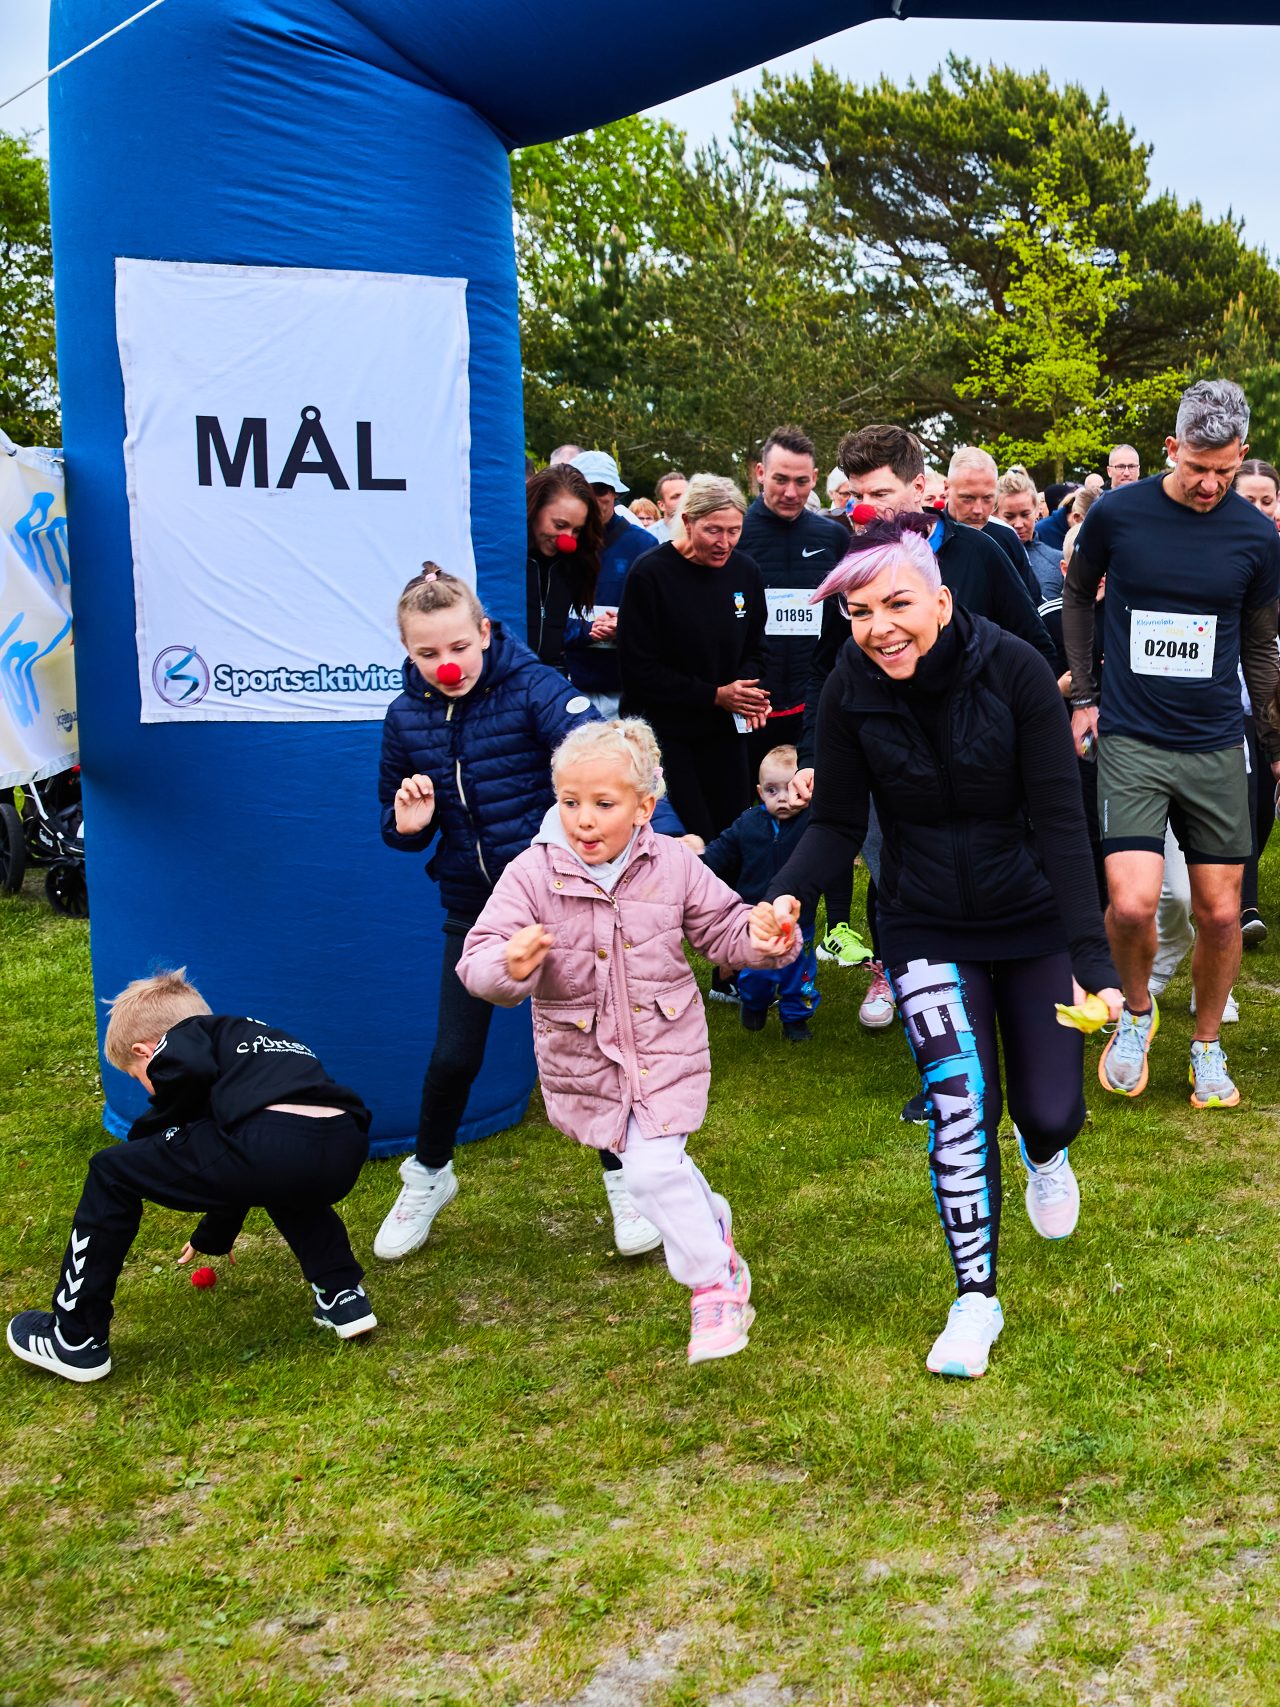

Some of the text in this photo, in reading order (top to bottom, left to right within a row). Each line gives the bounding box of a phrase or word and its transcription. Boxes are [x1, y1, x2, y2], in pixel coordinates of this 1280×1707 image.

[195, 405, 407, 491] MÅL
[776, 608, 813, 622] 01895
[1144, 639, 1200, 660] 02048
[214, 664, 404, 697] Sportsaktivite
